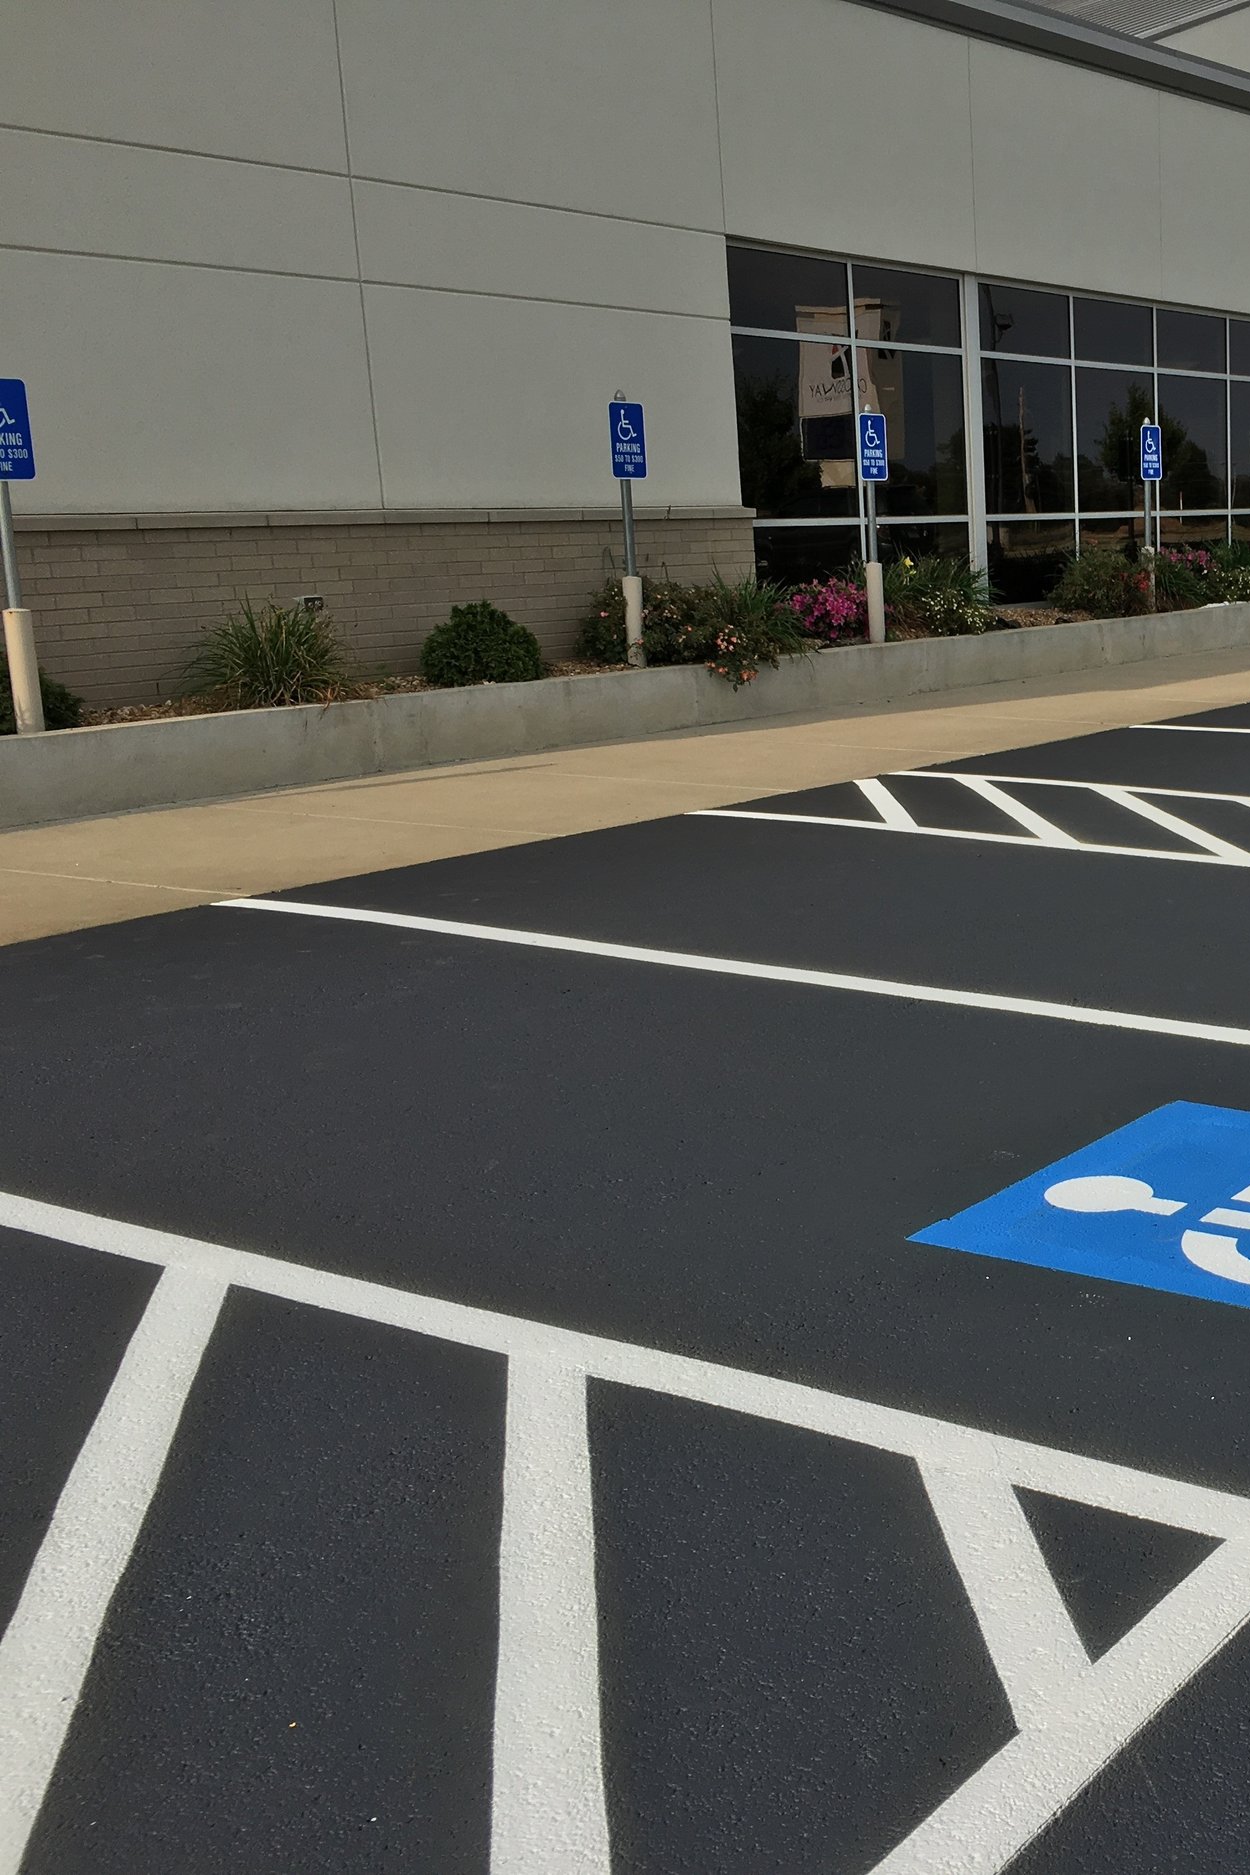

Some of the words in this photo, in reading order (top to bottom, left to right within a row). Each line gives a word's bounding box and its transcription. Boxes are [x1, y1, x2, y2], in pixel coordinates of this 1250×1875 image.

[0, 432, 23, 446] KING
[615, 442, 641, 454] PARKING
[864, 448, 883, 458] PARKING
[624, 464, 636, 472] FINE
